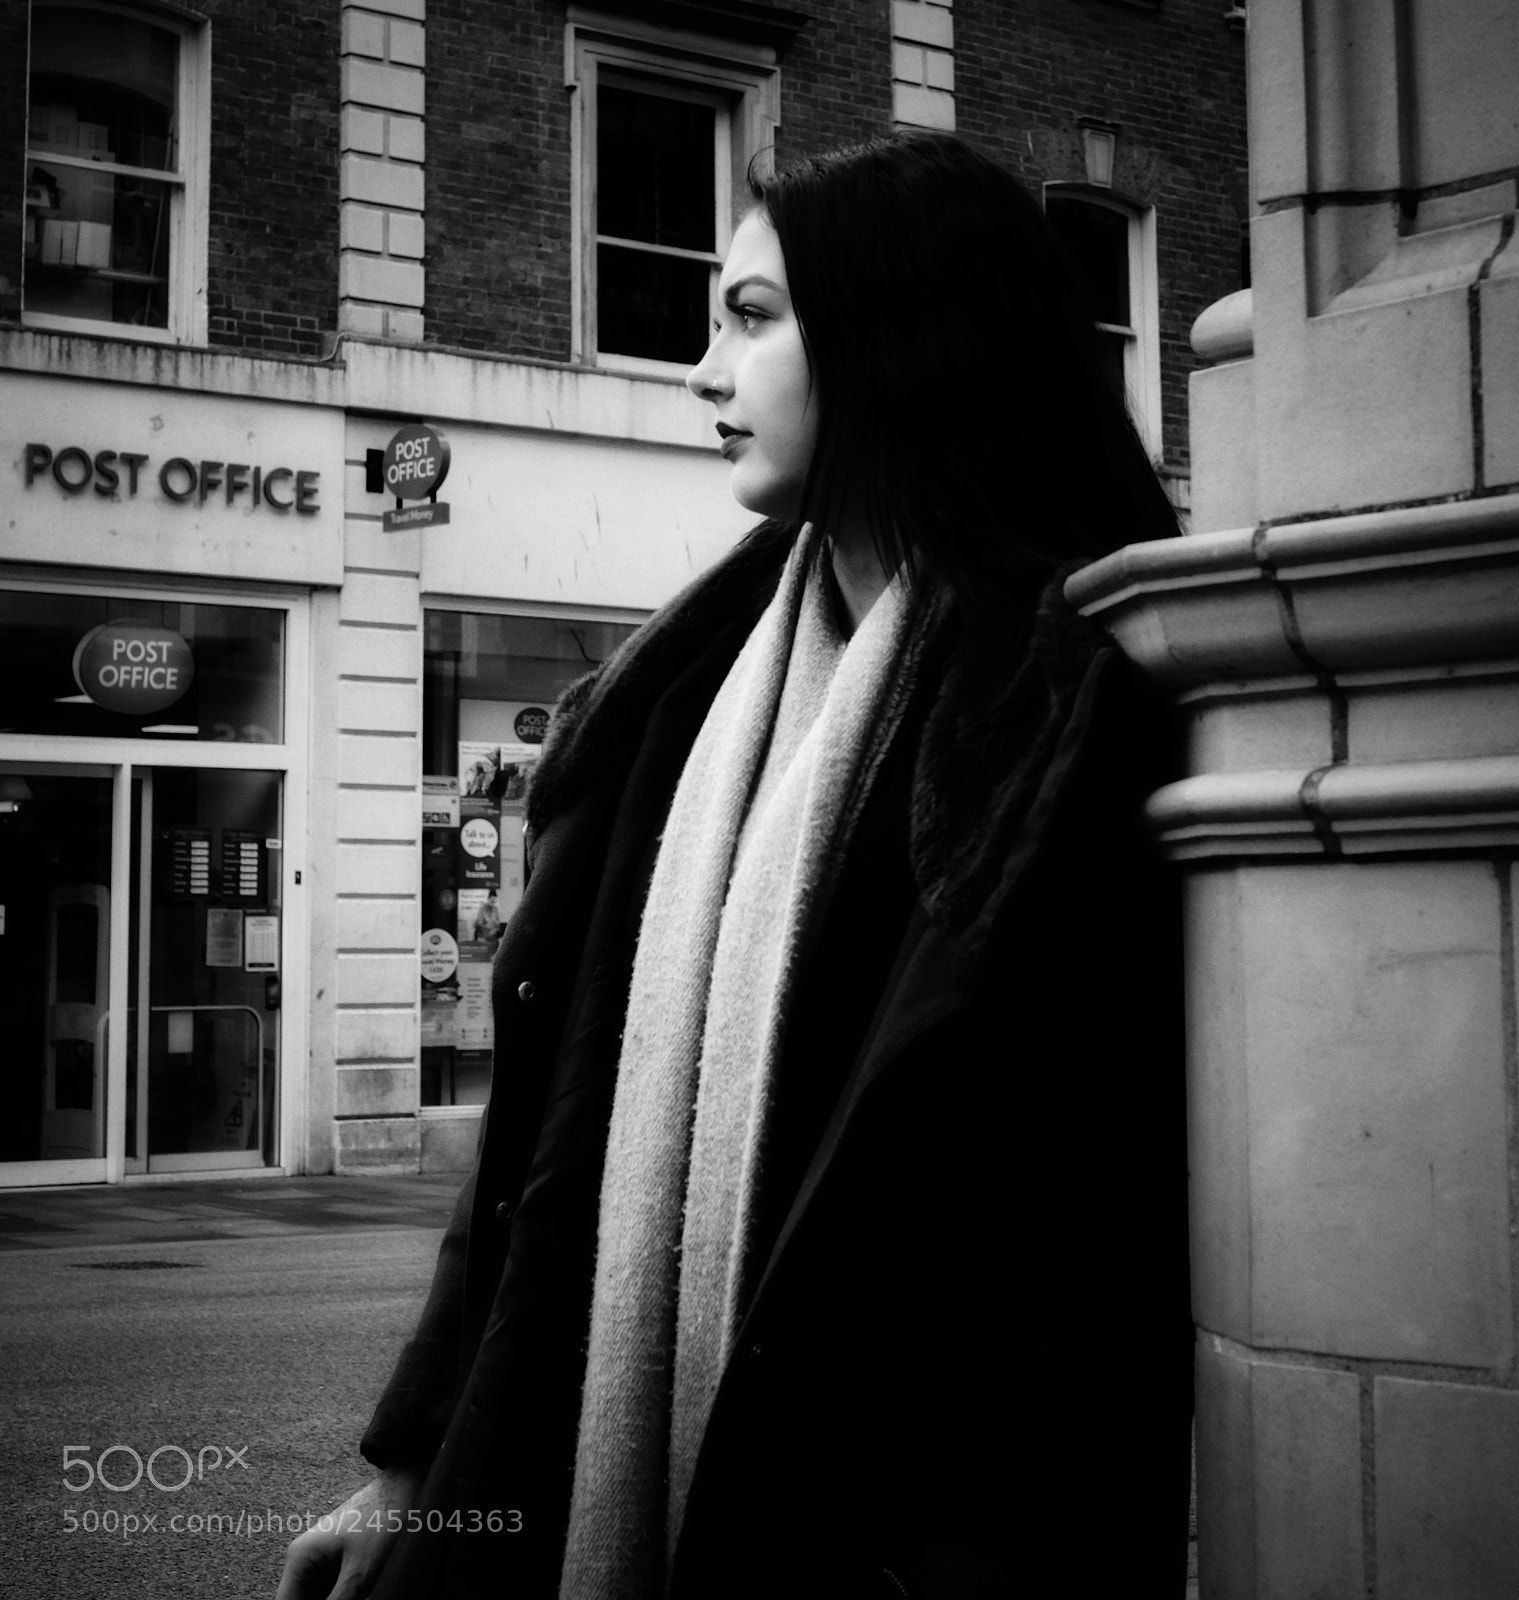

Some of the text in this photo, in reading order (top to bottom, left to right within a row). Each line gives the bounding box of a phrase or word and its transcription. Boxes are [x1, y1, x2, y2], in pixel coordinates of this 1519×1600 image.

[395, 437, 430, 461] POST
[24, 443, 321, 517] POST OFFICE
[387, 457, 435, 484] OFFICE
[113, 638, 172, 664] POST
[98, 665, 178, 691] OFFICE
[517, 725, 546, 737] OFFIC
